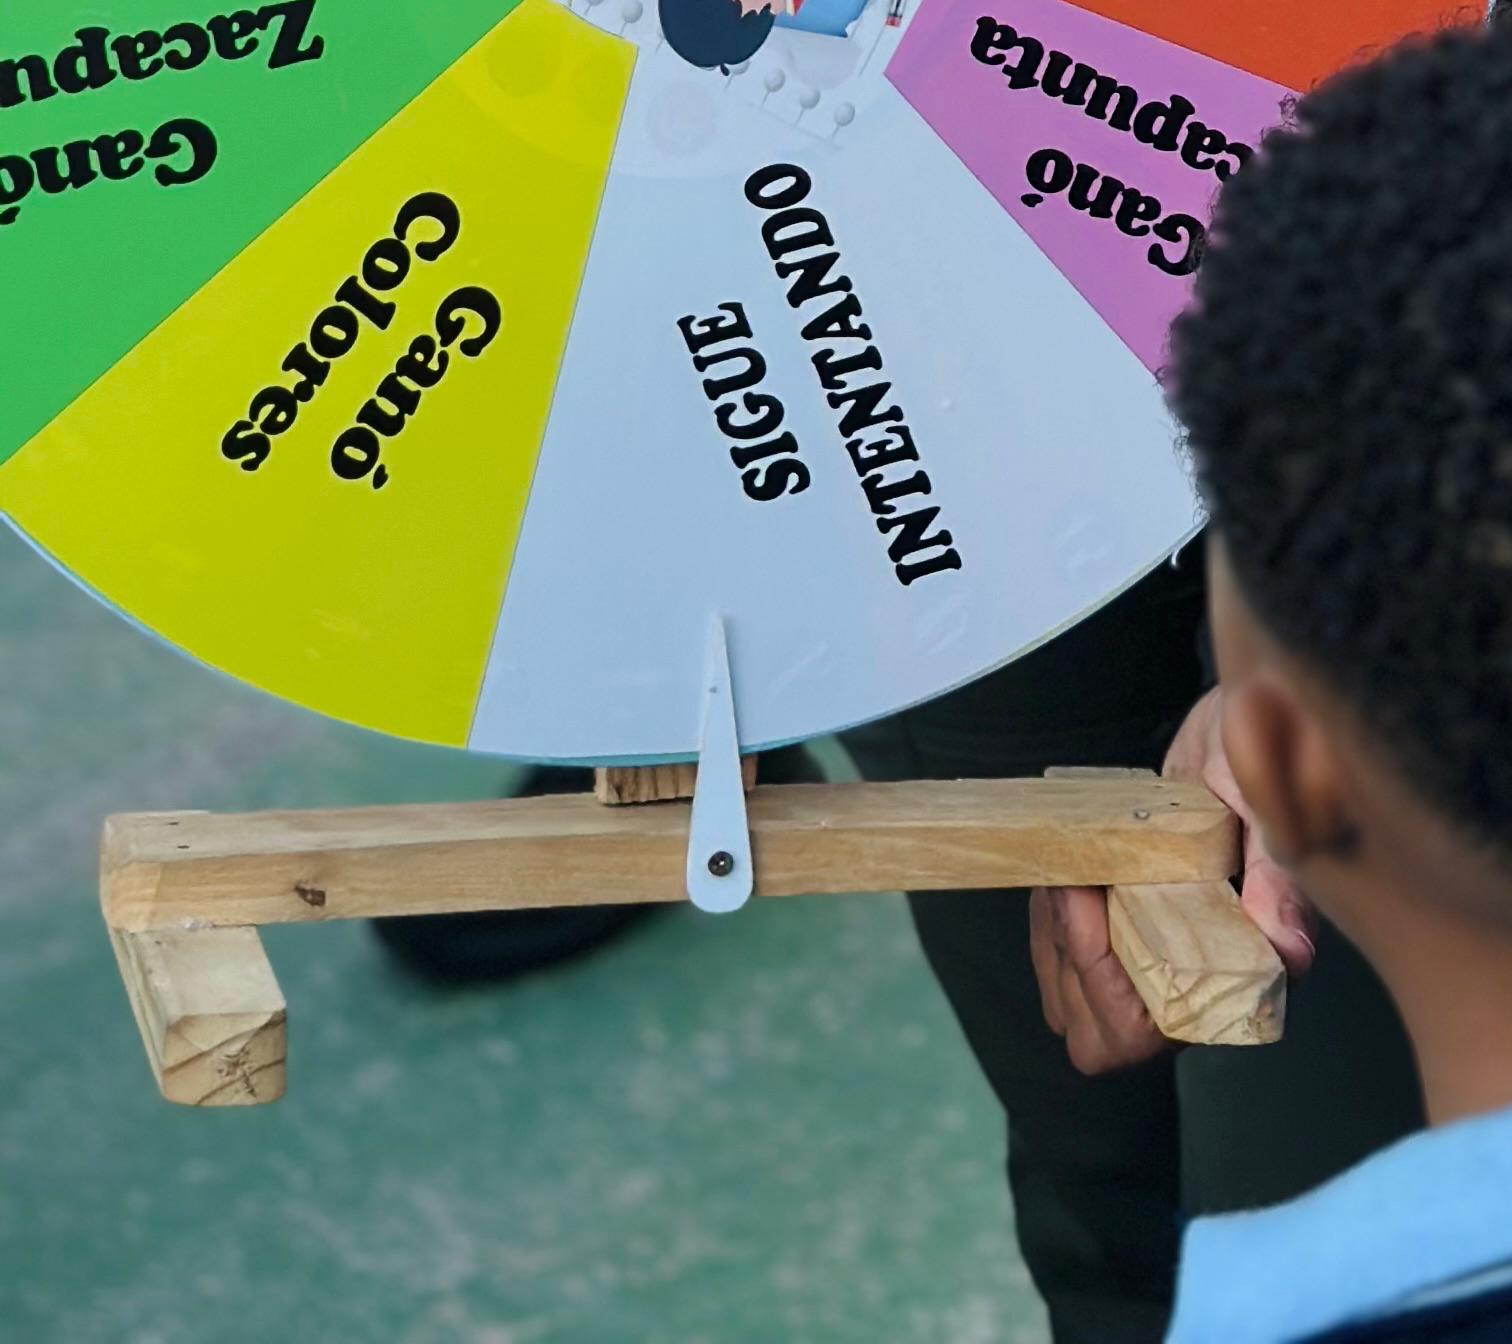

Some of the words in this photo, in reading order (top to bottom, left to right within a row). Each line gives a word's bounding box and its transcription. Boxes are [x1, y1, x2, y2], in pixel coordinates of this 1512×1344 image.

[1020, 148, 1207, 277] Ganó
[221, 191, 461, 472] Colores
[331, 285, 502, 490] Ganó
[676, 301, 811, 502] SIGUE
[744, 163, 963, 587] INTENTANDO
